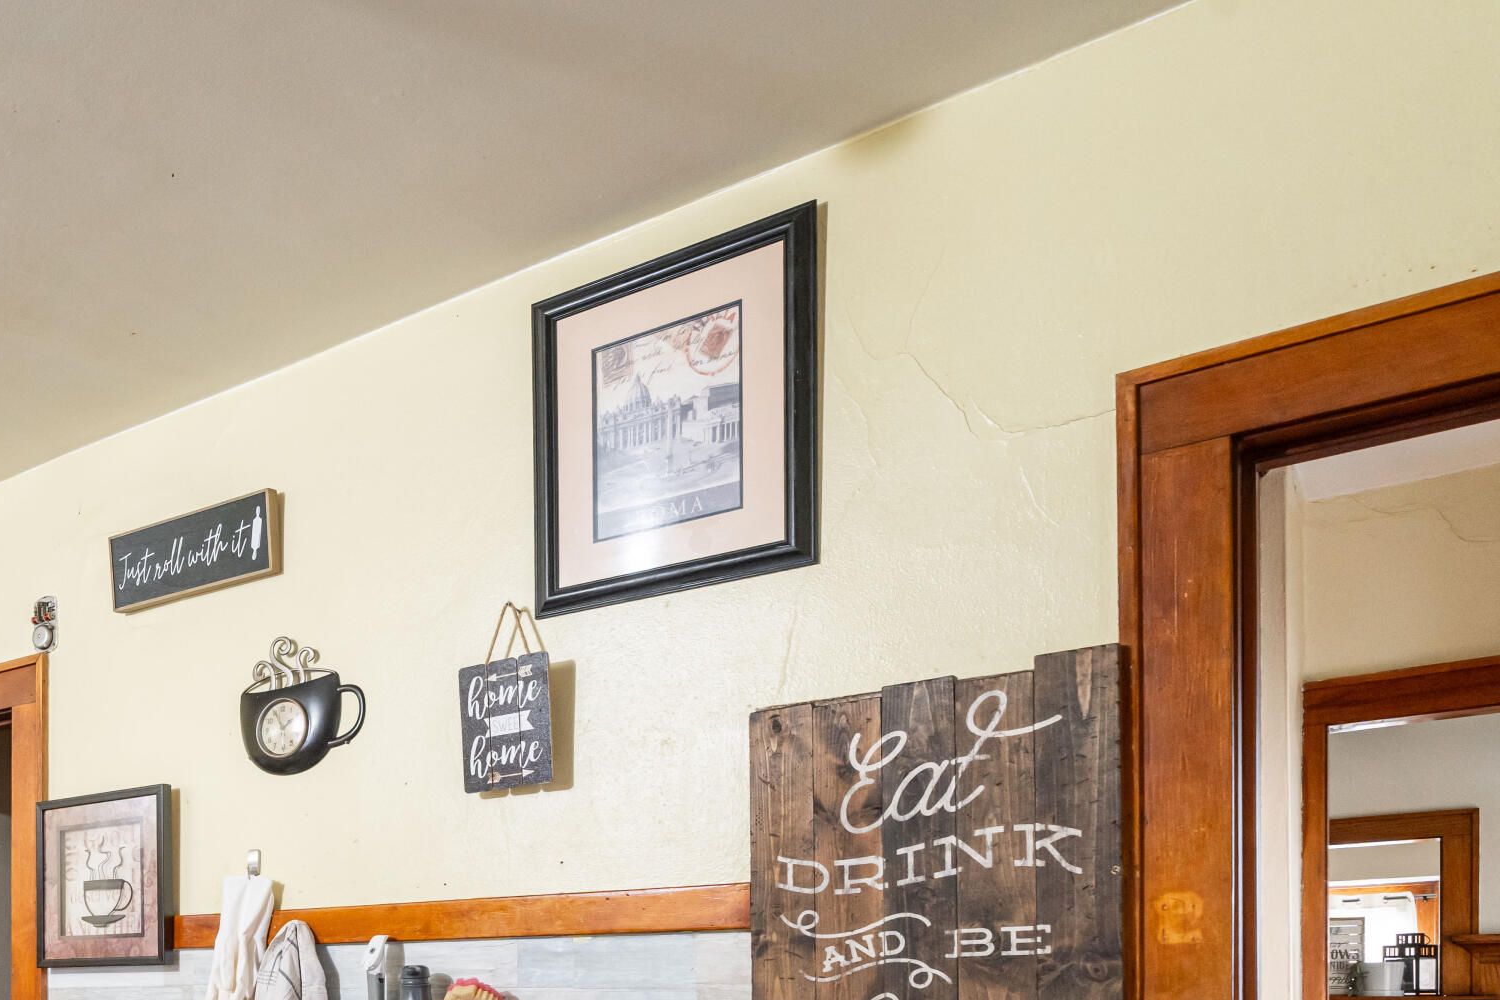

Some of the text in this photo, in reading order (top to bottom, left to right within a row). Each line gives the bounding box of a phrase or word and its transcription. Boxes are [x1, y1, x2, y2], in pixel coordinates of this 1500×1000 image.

[118, 519, 251, 590] Just roll with it
[468, 676, 541, 720] home
[470, 735, 543, 779] home
[840, 690, 1062, 834] Eat
[777, 822, 1084, 896] DRINK
[822, 924, 1052, 973] AND BE
